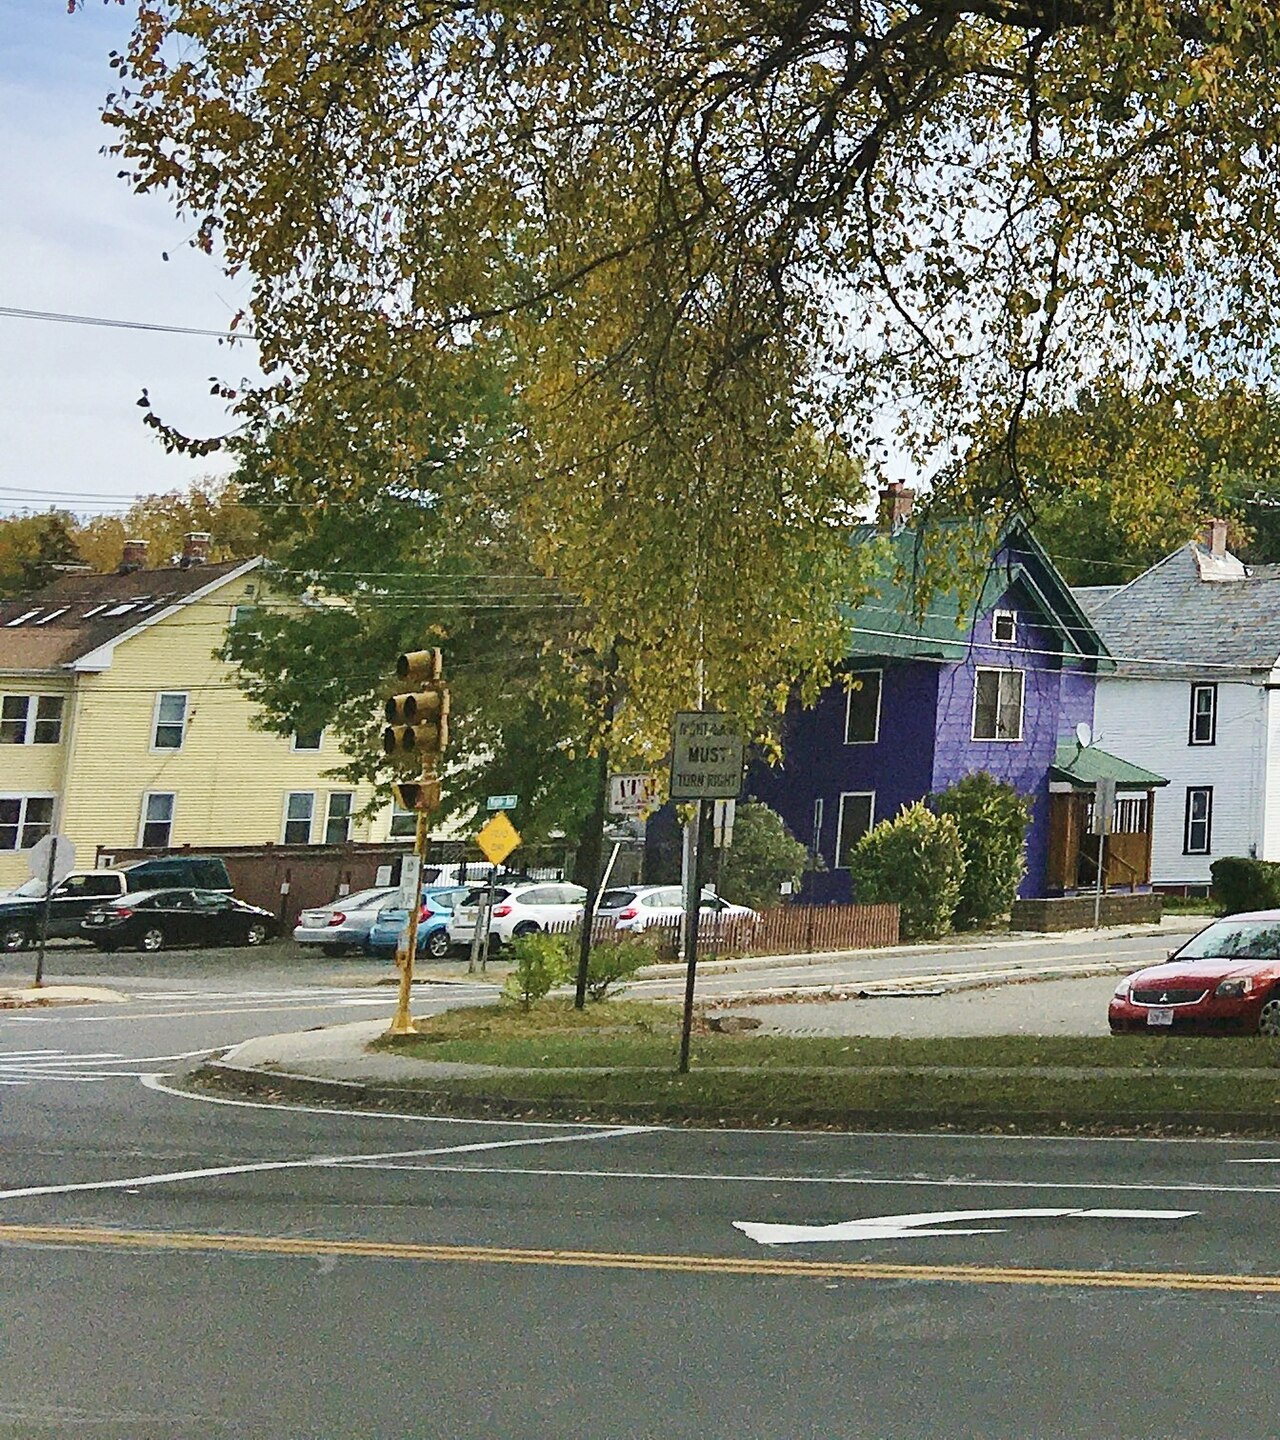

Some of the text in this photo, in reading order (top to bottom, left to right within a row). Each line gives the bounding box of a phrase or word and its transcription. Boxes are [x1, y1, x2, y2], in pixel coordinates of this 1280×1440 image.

[689, 747, 728, 763] MUST
[677, 773, 737, 787] TURN RIGHT
